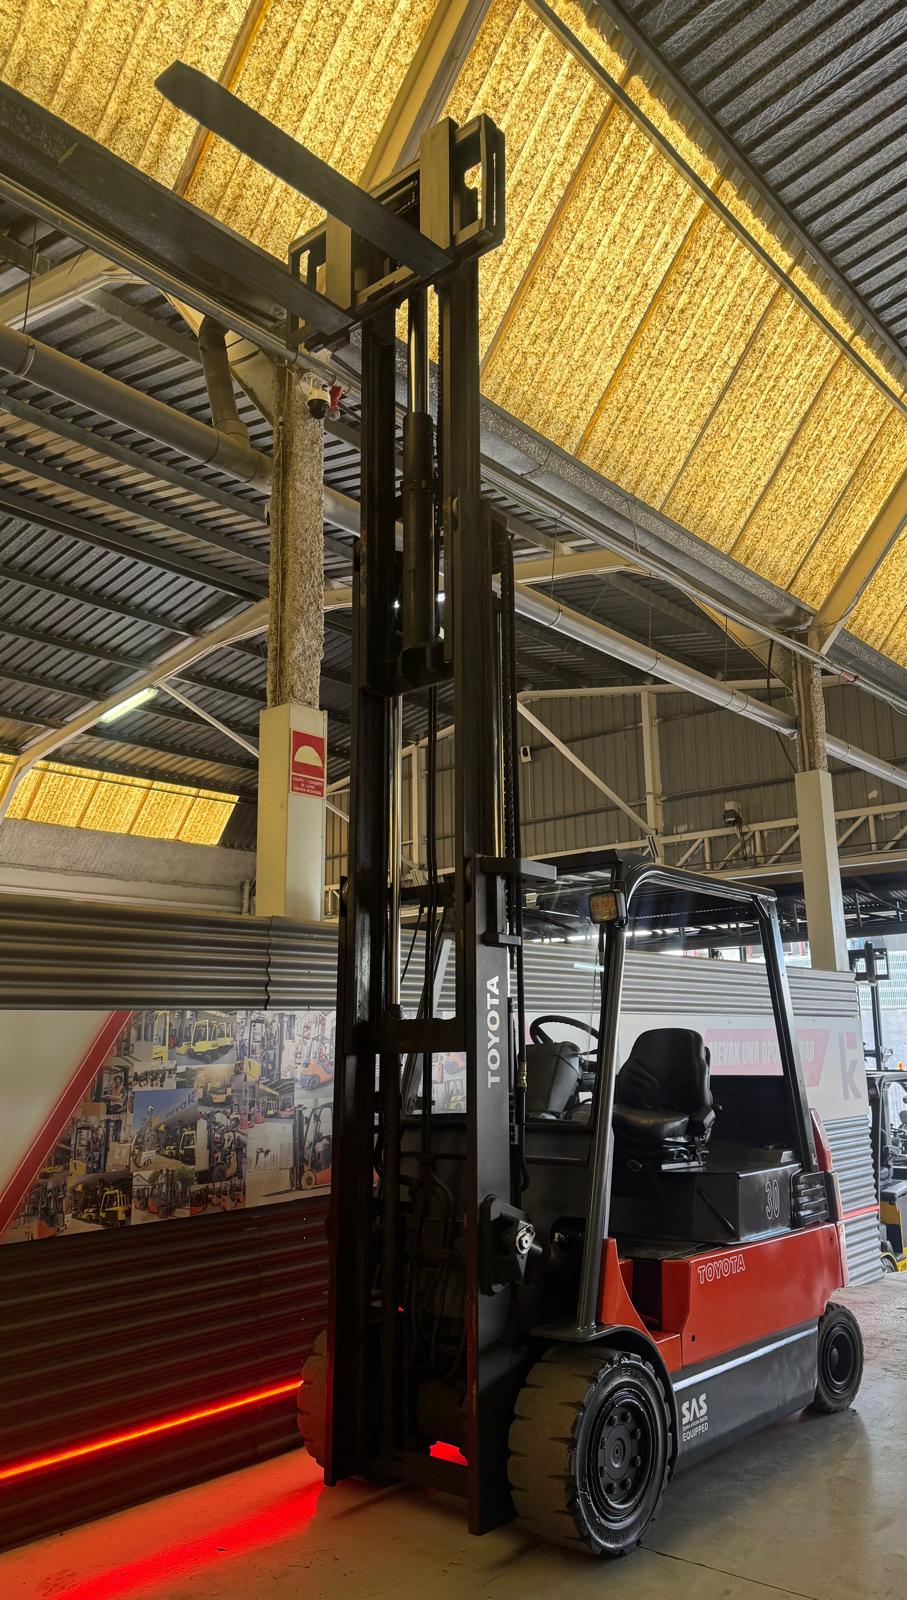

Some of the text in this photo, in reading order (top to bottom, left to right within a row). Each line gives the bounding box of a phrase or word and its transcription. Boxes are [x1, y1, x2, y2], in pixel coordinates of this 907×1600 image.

[486, 975, 501, 1088] TOYOTA
[765, 1179, 781, 1220] 30
[697, 1254, 746, 1285] TOYOTA
[681, 1393, 708, 1425] SAS
[682, 1422, 709, 1442] EQUIPPED
